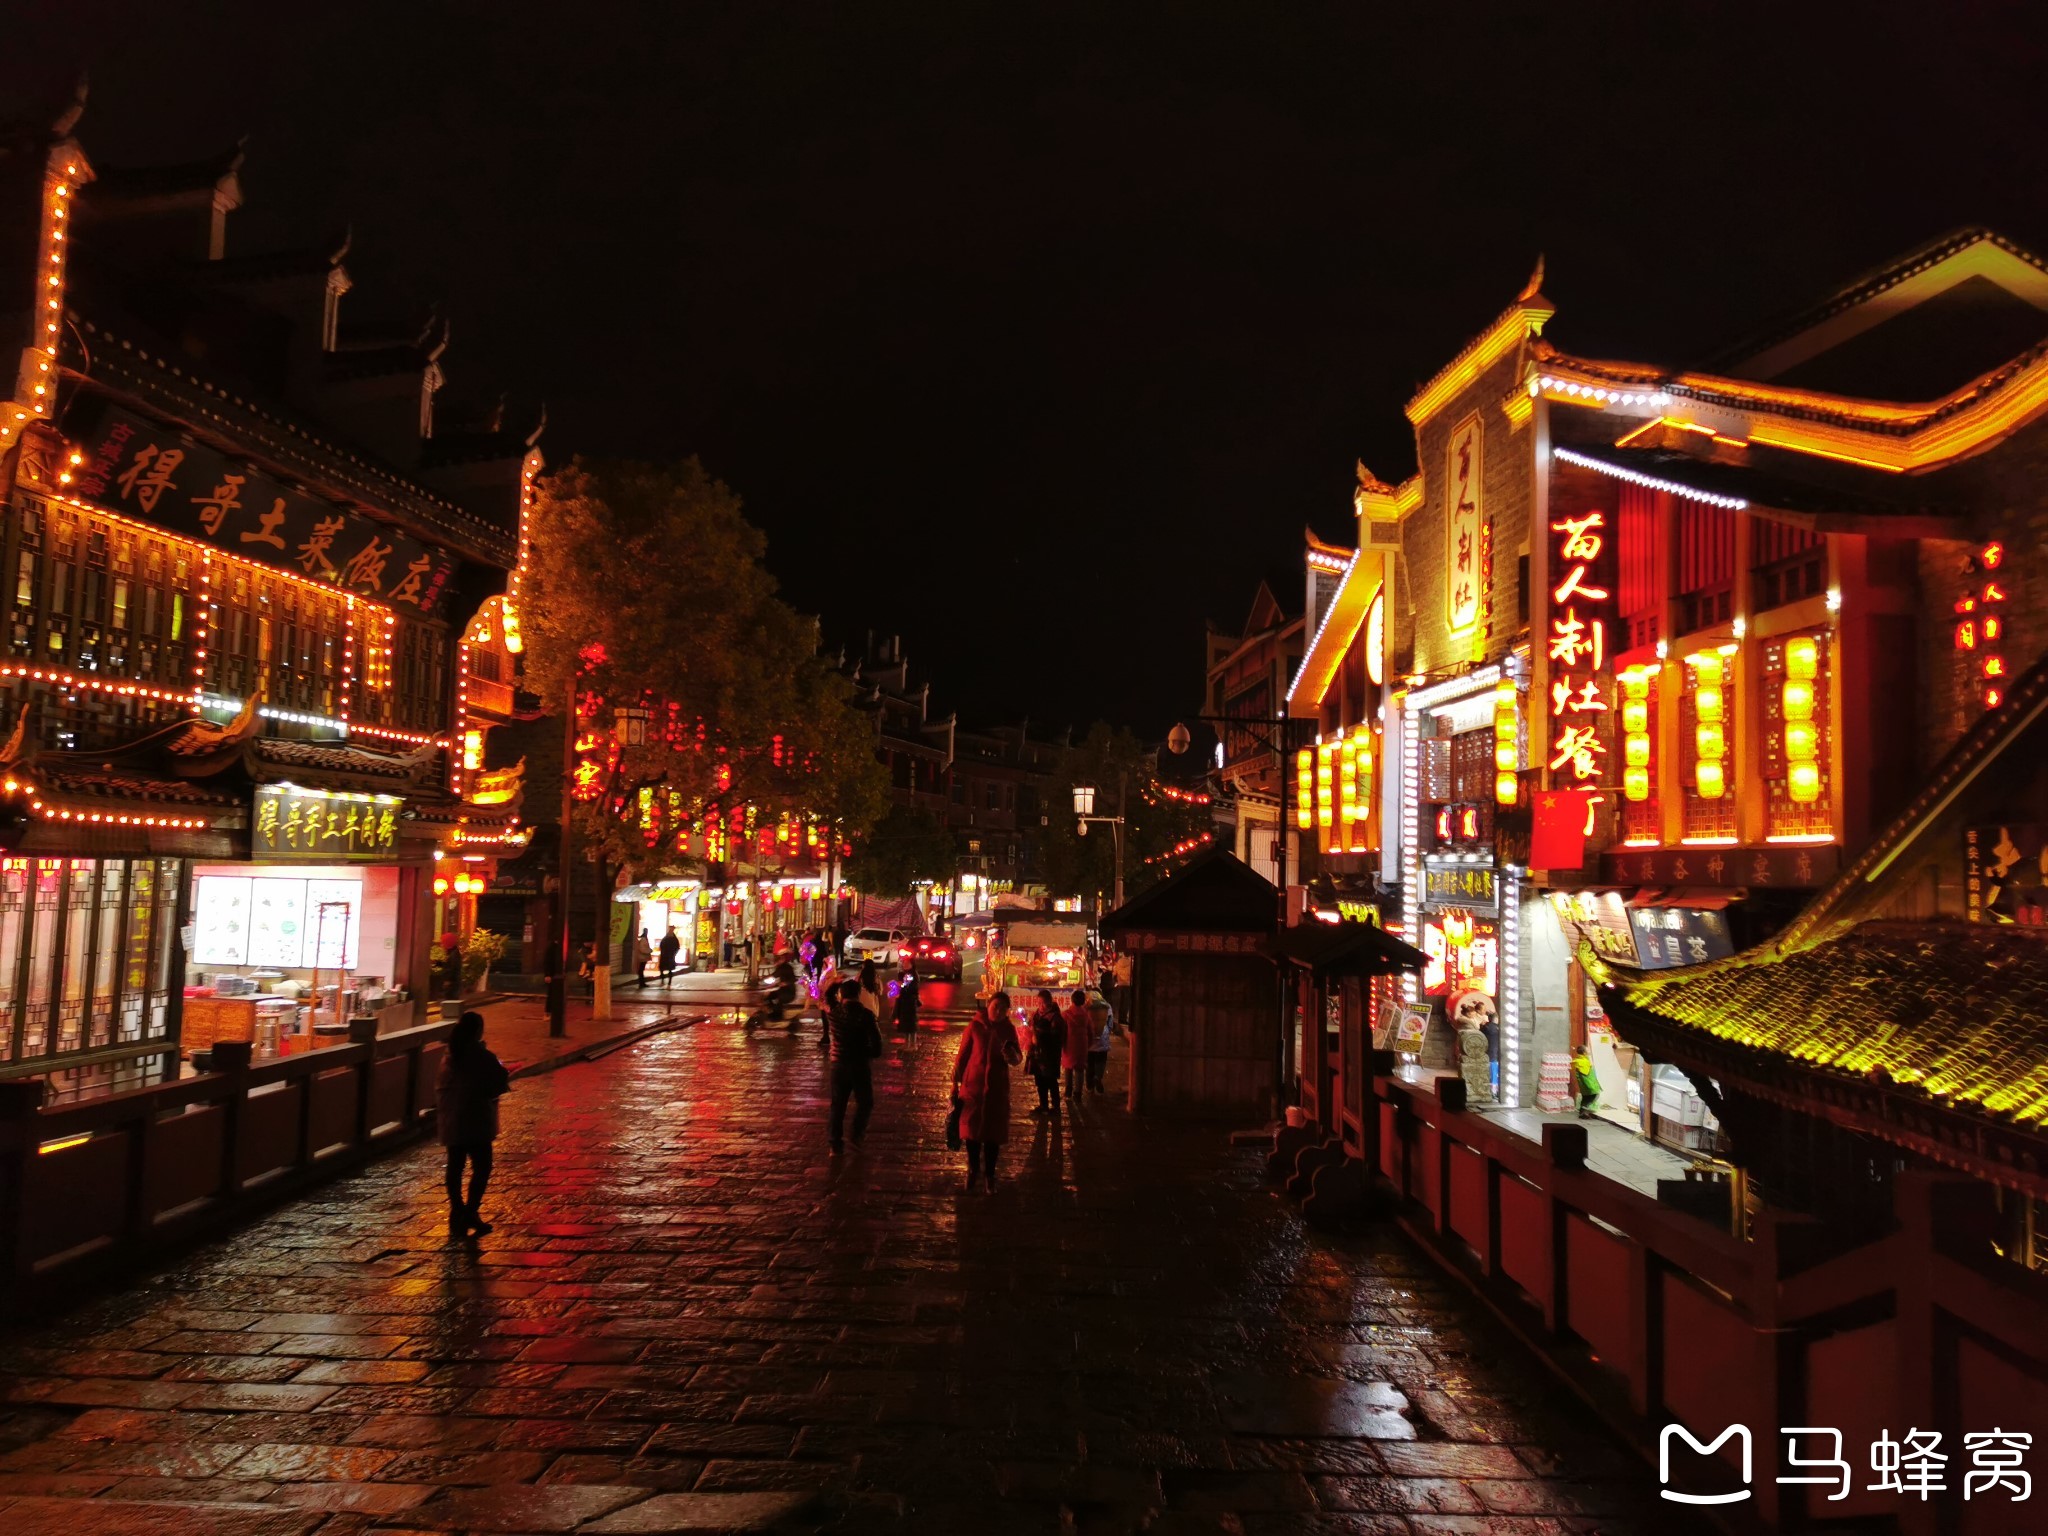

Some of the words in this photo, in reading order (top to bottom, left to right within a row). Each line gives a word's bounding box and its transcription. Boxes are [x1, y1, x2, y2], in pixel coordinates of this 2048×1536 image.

[117, 443, 433, 606] 得哥土菜饭庄
[1664, 934, 1709, 966] 皇茶
